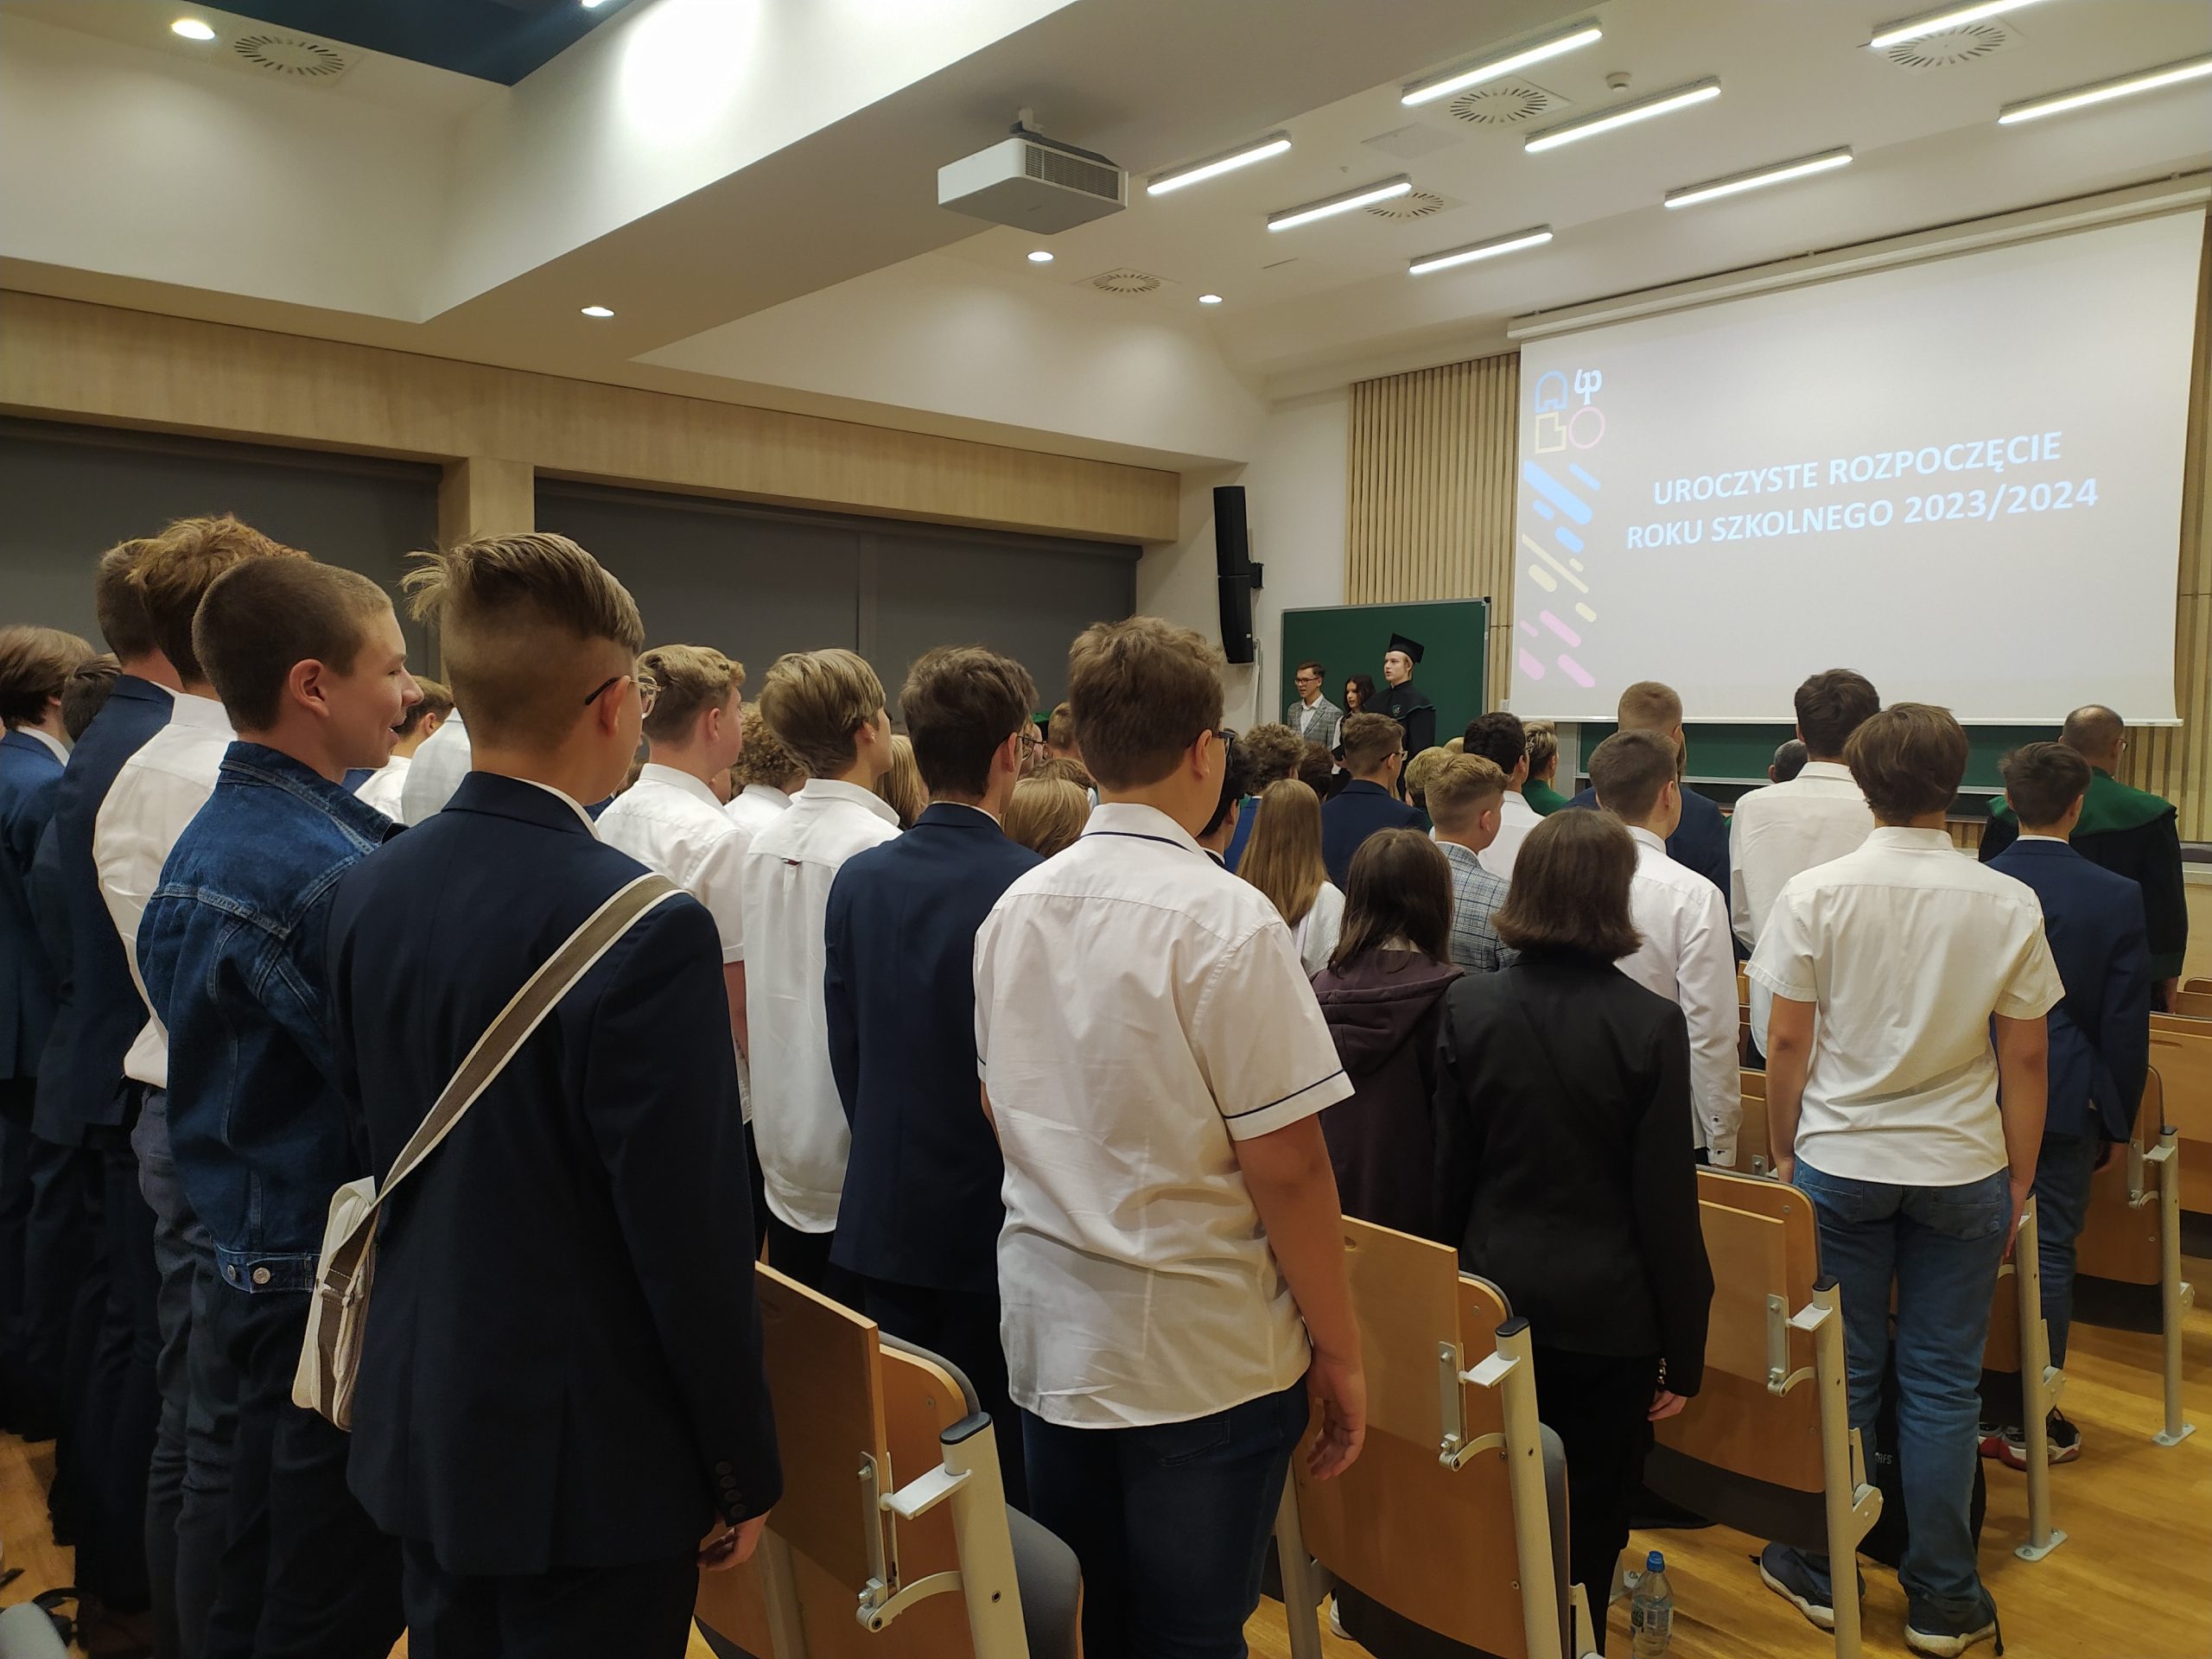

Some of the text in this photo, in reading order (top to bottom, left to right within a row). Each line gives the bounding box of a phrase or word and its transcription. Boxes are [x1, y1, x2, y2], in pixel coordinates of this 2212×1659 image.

[1654, 431, 2062, 505] UROCZYSTE ROZPOCZĘCIE
[1627, 478, 2098, 550] ROKU SZKOLNEGO 2023/2024
